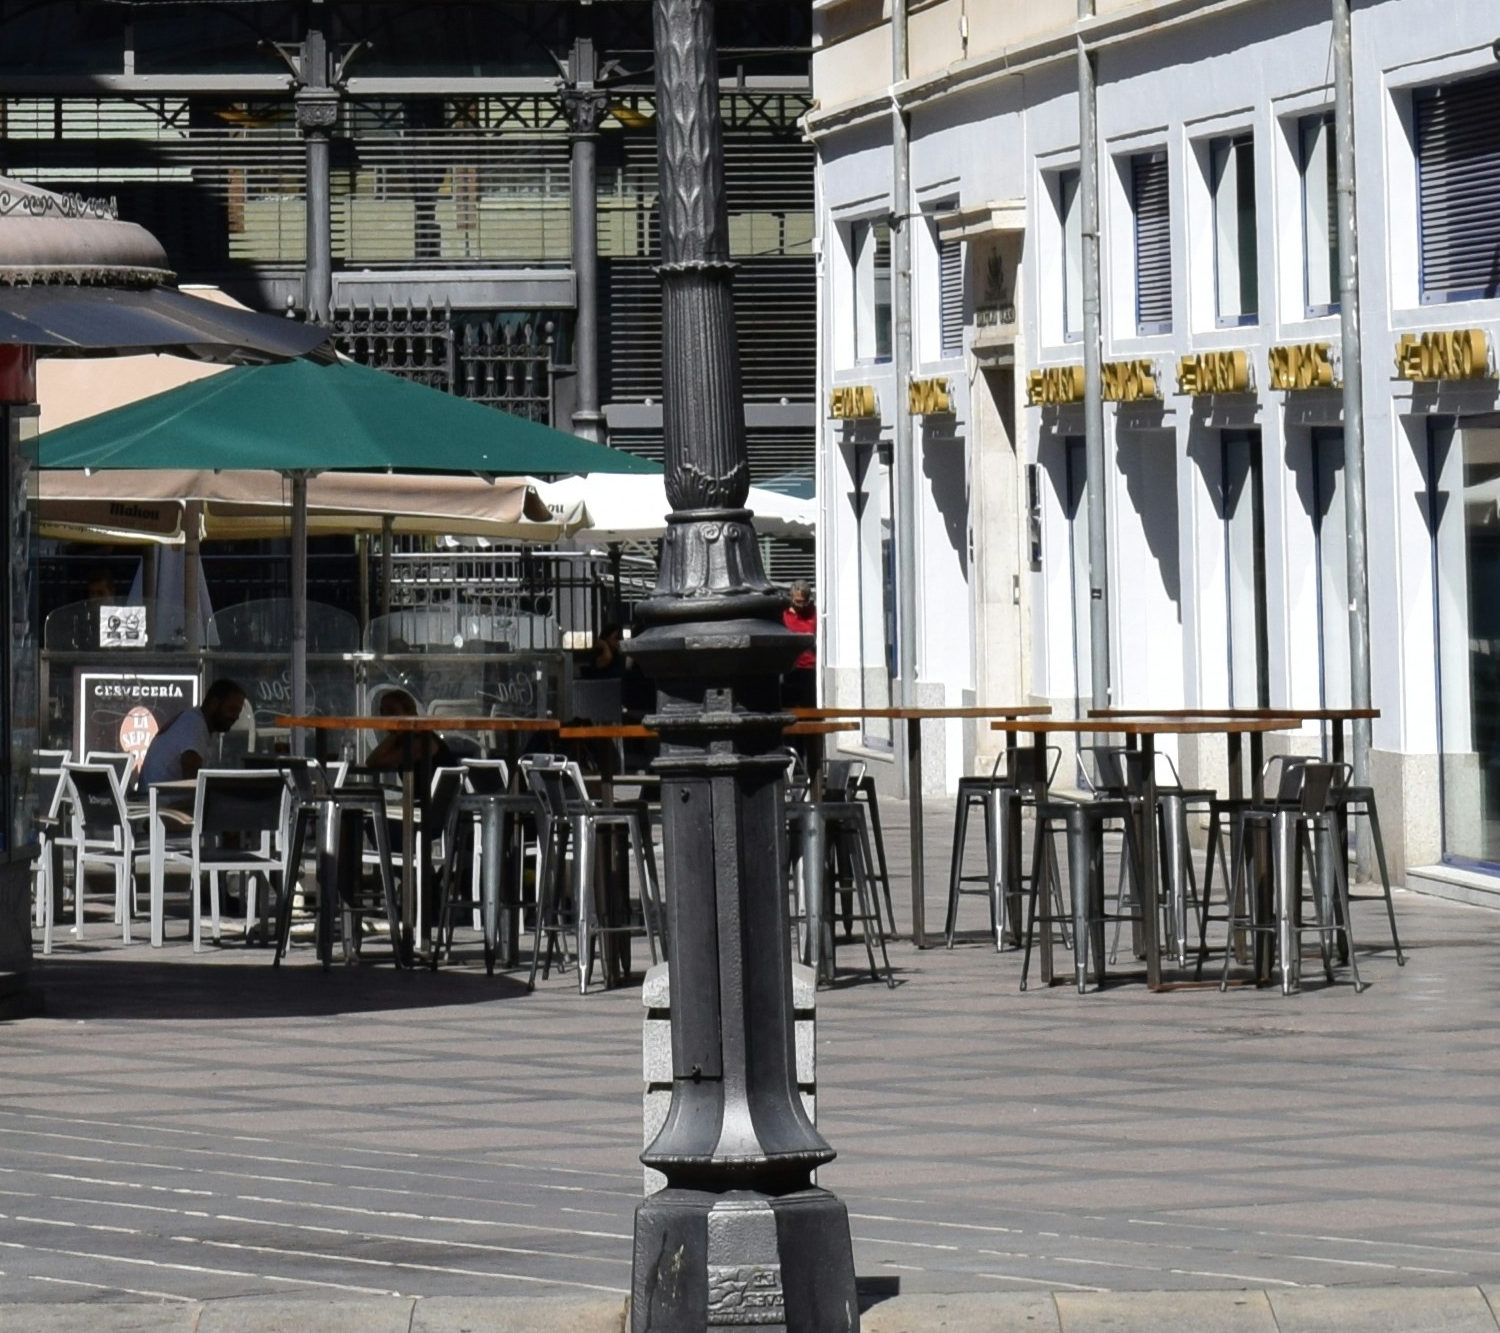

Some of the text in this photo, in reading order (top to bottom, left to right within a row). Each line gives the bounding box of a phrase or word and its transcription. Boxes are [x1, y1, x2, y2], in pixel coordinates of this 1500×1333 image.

[109, 502, 160, 521] Mahou
[94, 683, 184, 698] CERVECERÍA
[133, 716, 149, 729] LA
